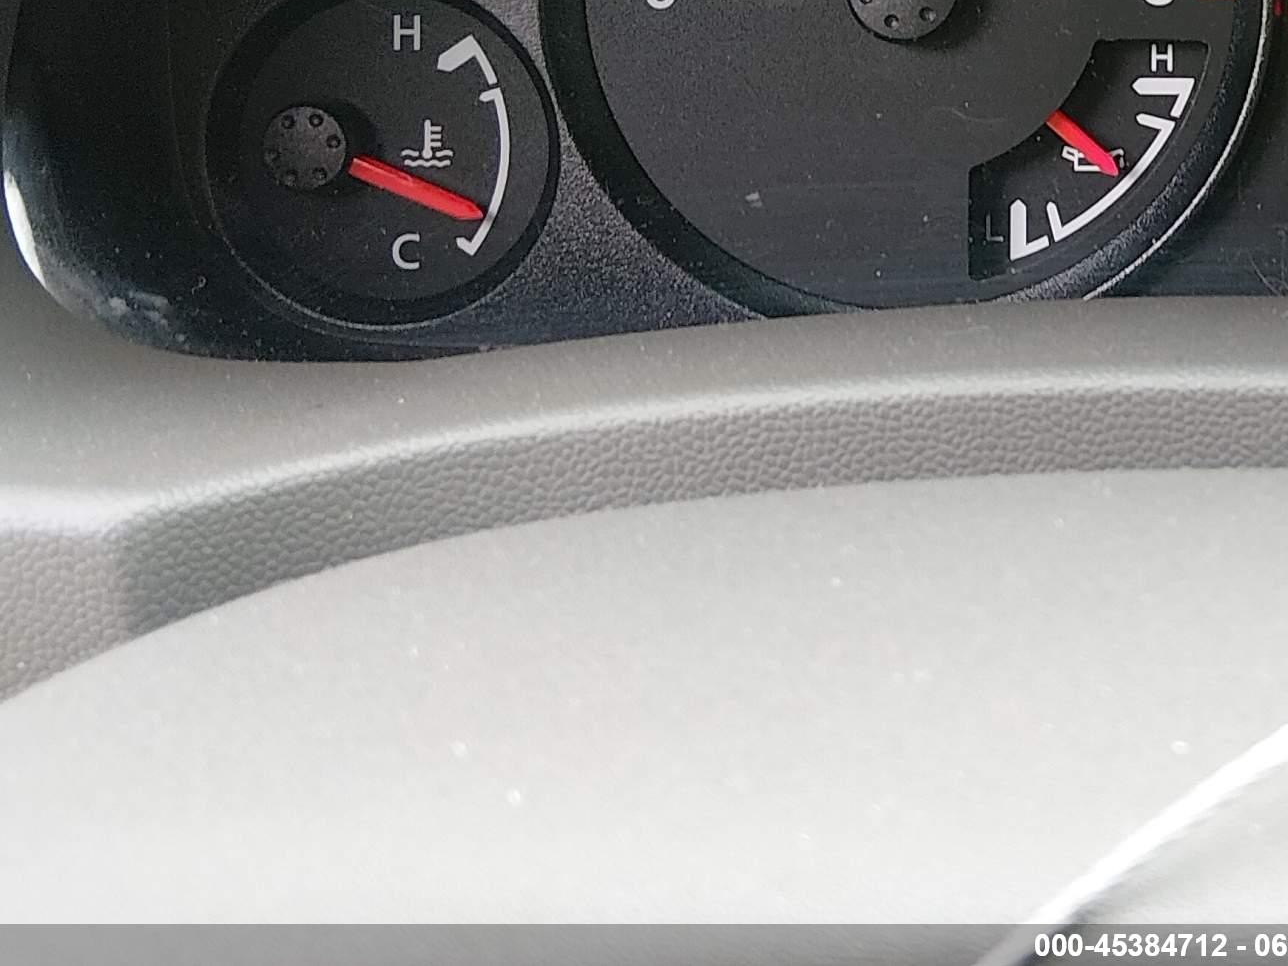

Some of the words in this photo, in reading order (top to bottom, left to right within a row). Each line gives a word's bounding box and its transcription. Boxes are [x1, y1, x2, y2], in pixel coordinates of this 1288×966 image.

[393, 15, 421, 51] H
[1151, 45, 1173, 72] H
[391, 234, 421, 270] C
